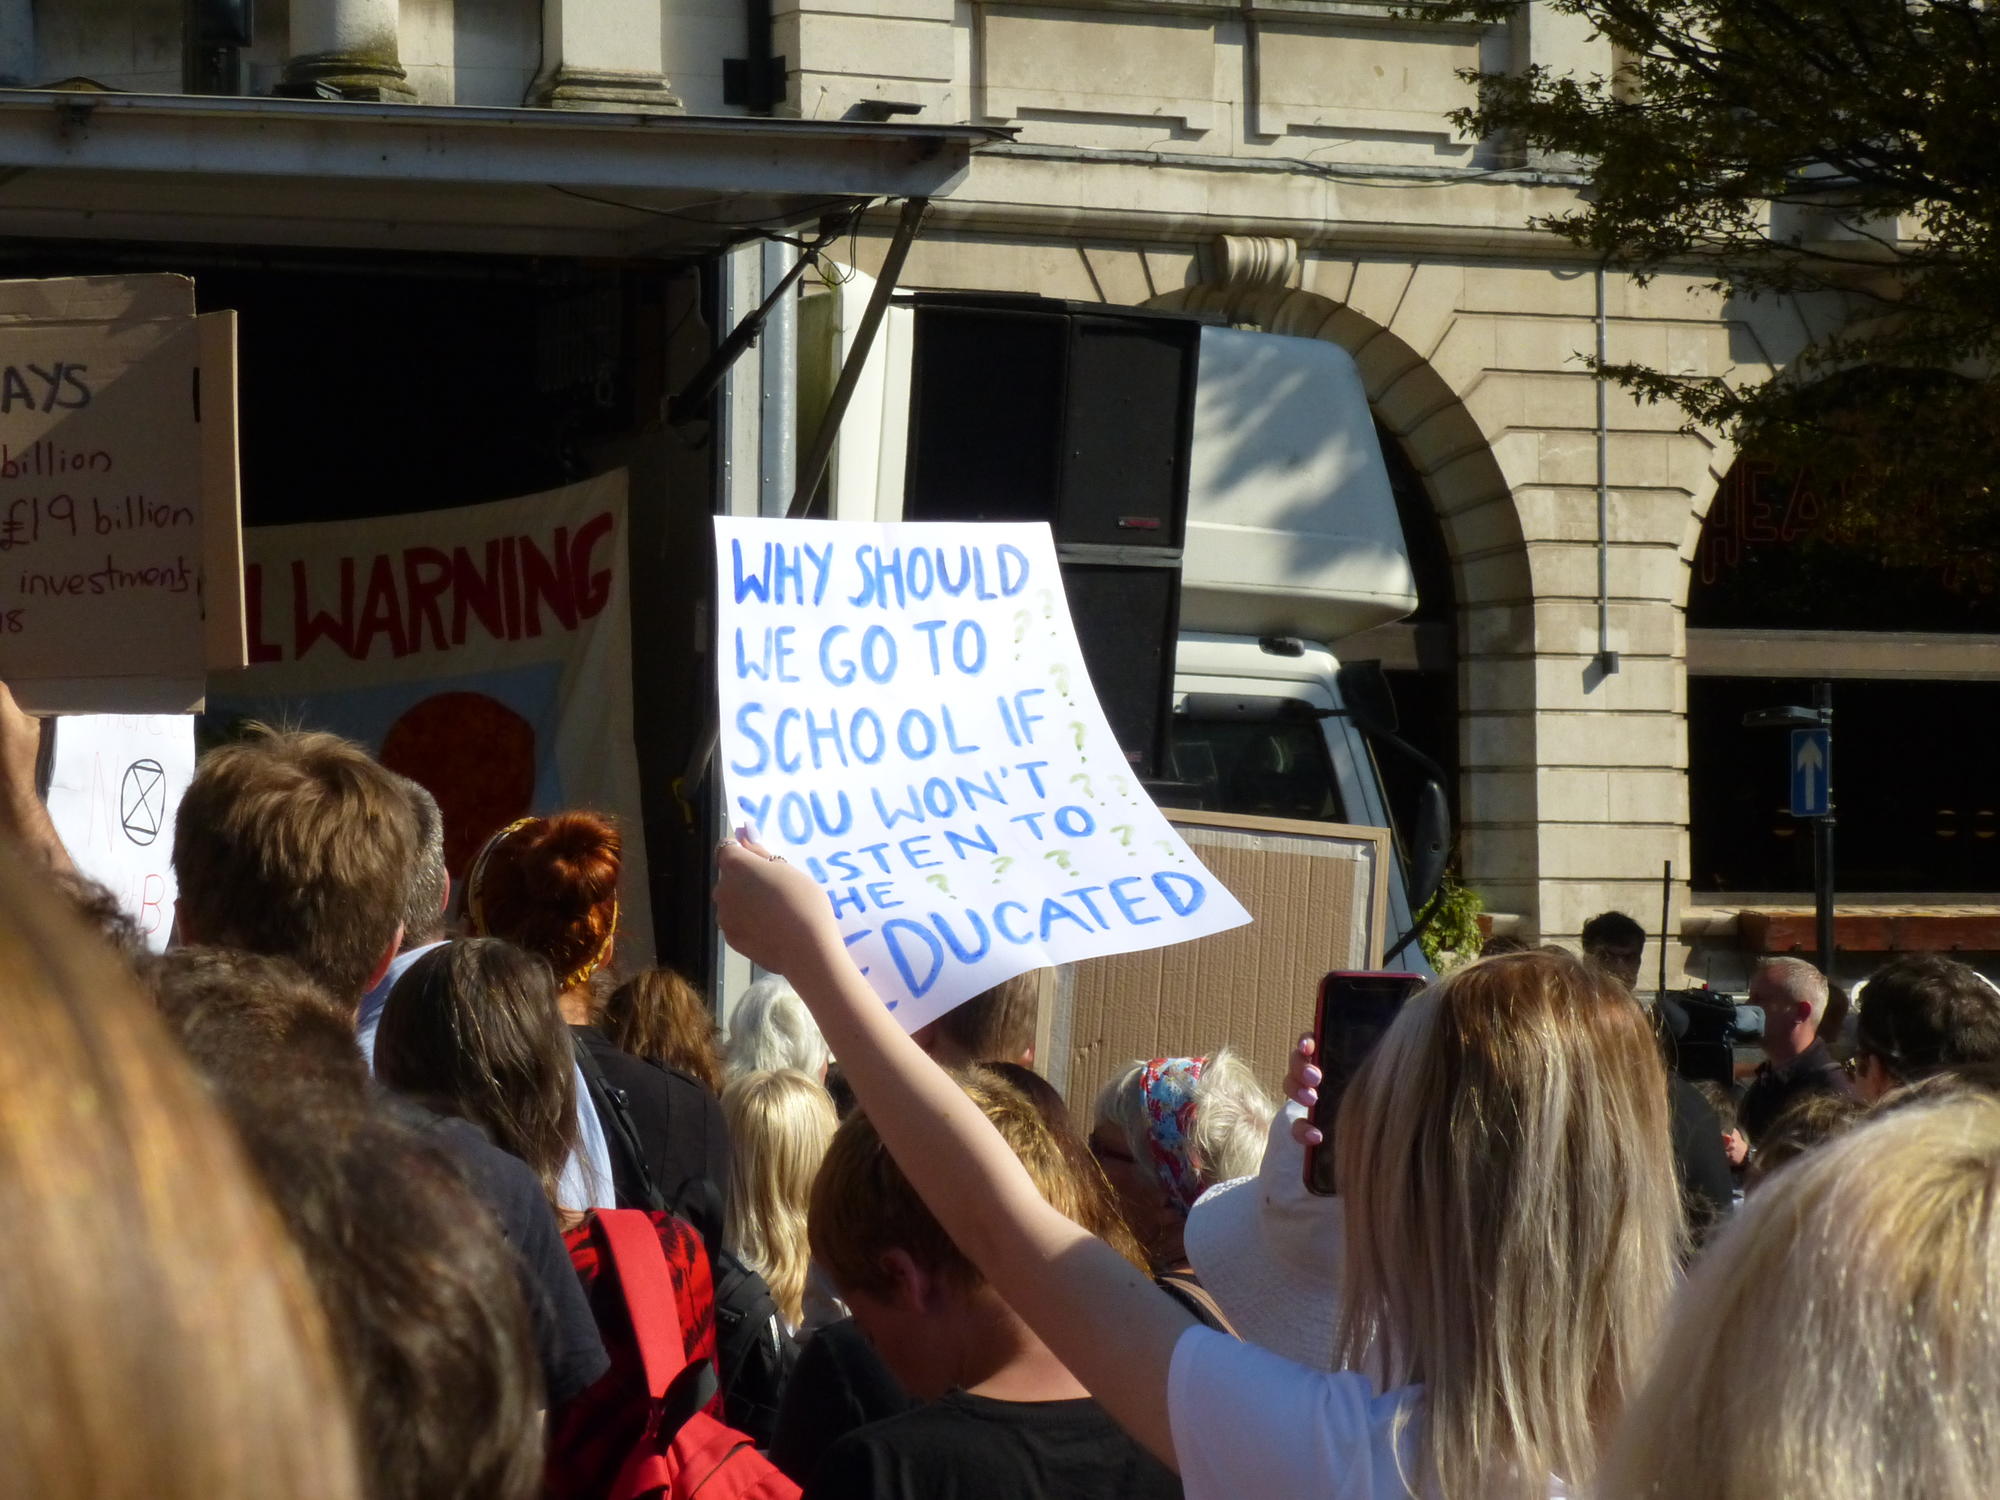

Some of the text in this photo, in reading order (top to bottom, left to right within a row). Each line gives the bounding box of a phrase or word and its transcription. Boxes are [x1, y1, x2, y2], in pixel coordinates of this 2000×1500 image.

[1, 363, 91, 413] AYS
[1, 440, 112, 479] billion
[0, 494, 195, 550] £19 billion
[246, 512, 614, 663] L WARNING
[731, 538, 833, 606] WHY
[848, 543, 1030, 609] SHOULD
[735, 625, 800, 682] WE
[818, 624, 898, 687] GO
[913, 619, 987, 676] TO
[730, 702, 981, 777] SCHOOL
[997, 688, 1046, 747] IF
[737, 788, 854, 845] YOU
[871, 760, 1048, 830] WON'T
[805, 824, 998, 884] ISTEN
[1009, 805, 1096, 841] TO
[827, 881, 905, 920] HE
